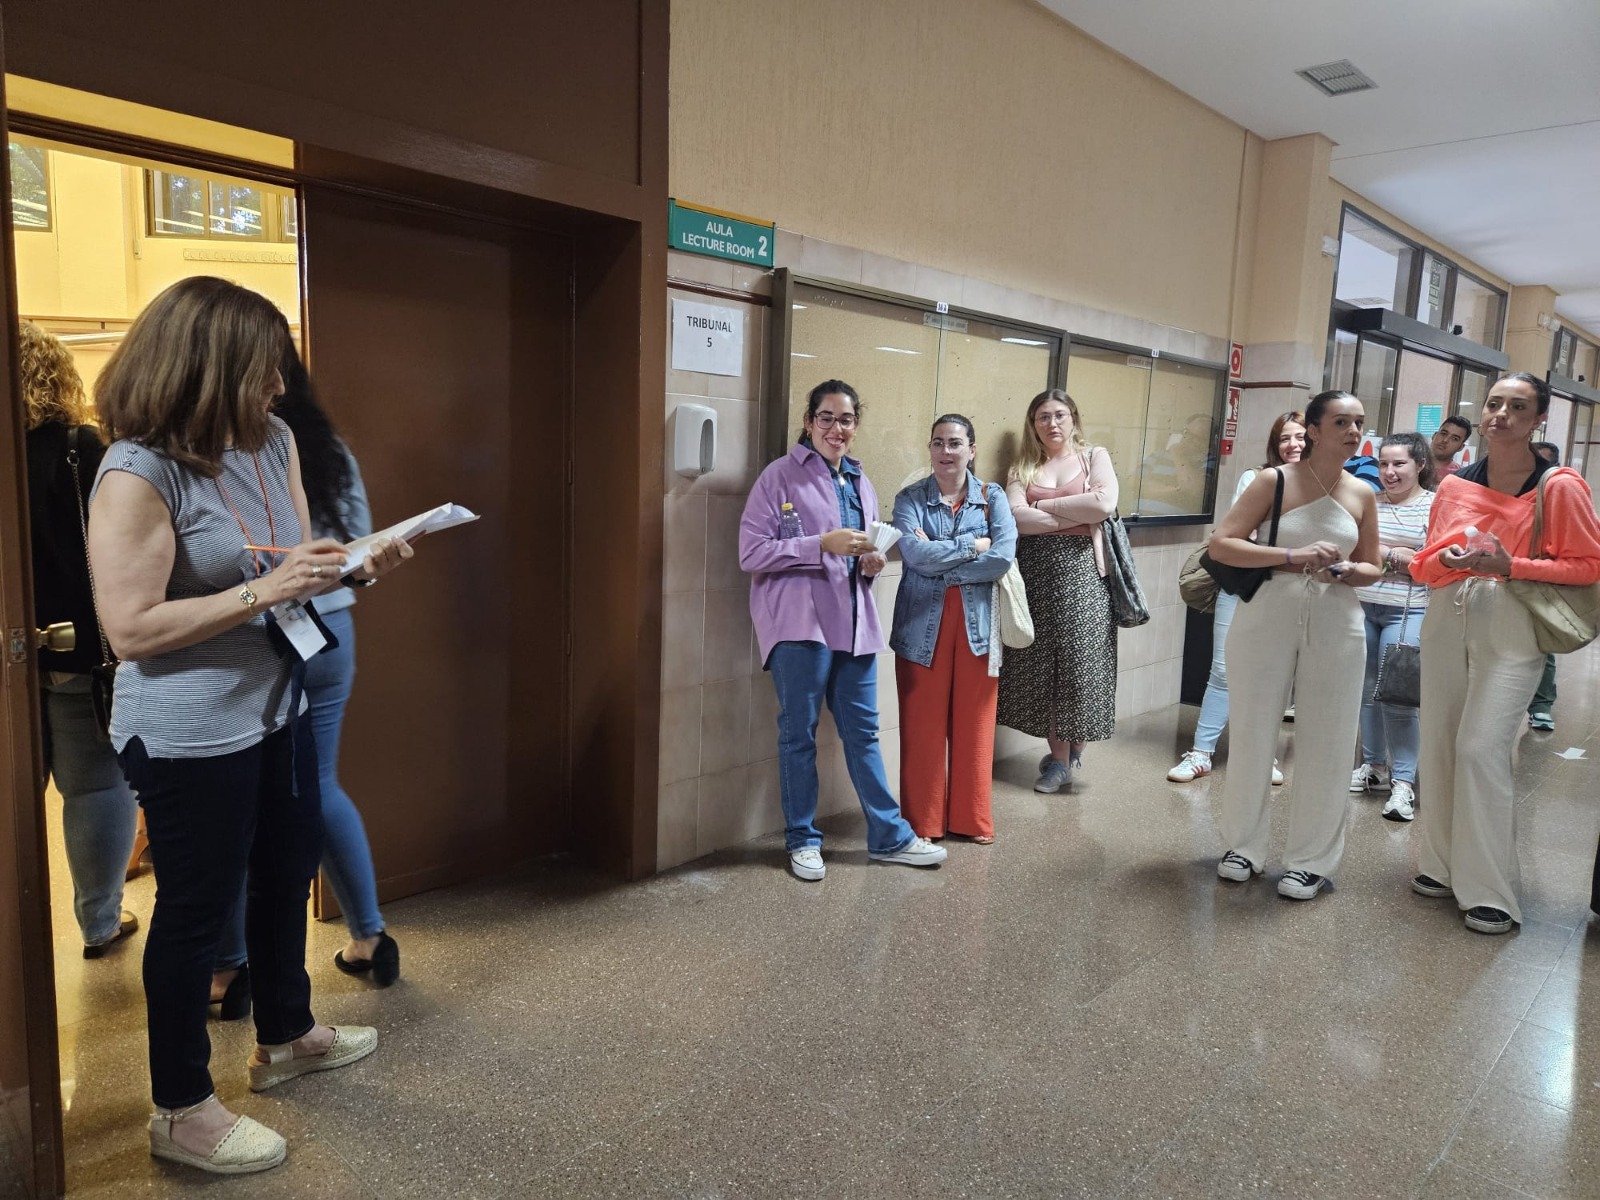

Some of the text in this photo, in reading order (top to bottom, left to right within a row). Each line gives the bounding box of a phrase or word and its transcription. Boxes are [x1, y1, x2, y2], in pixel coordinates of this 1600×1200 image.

[706, 221, 733, 237] AULA
[683, 232, 754, 258] LECTURE ROOM
[758, 236, 767, 256] 2
[687, 315, 733, 333] TRIBUNAL
[706, 337, 713, 347] 5
